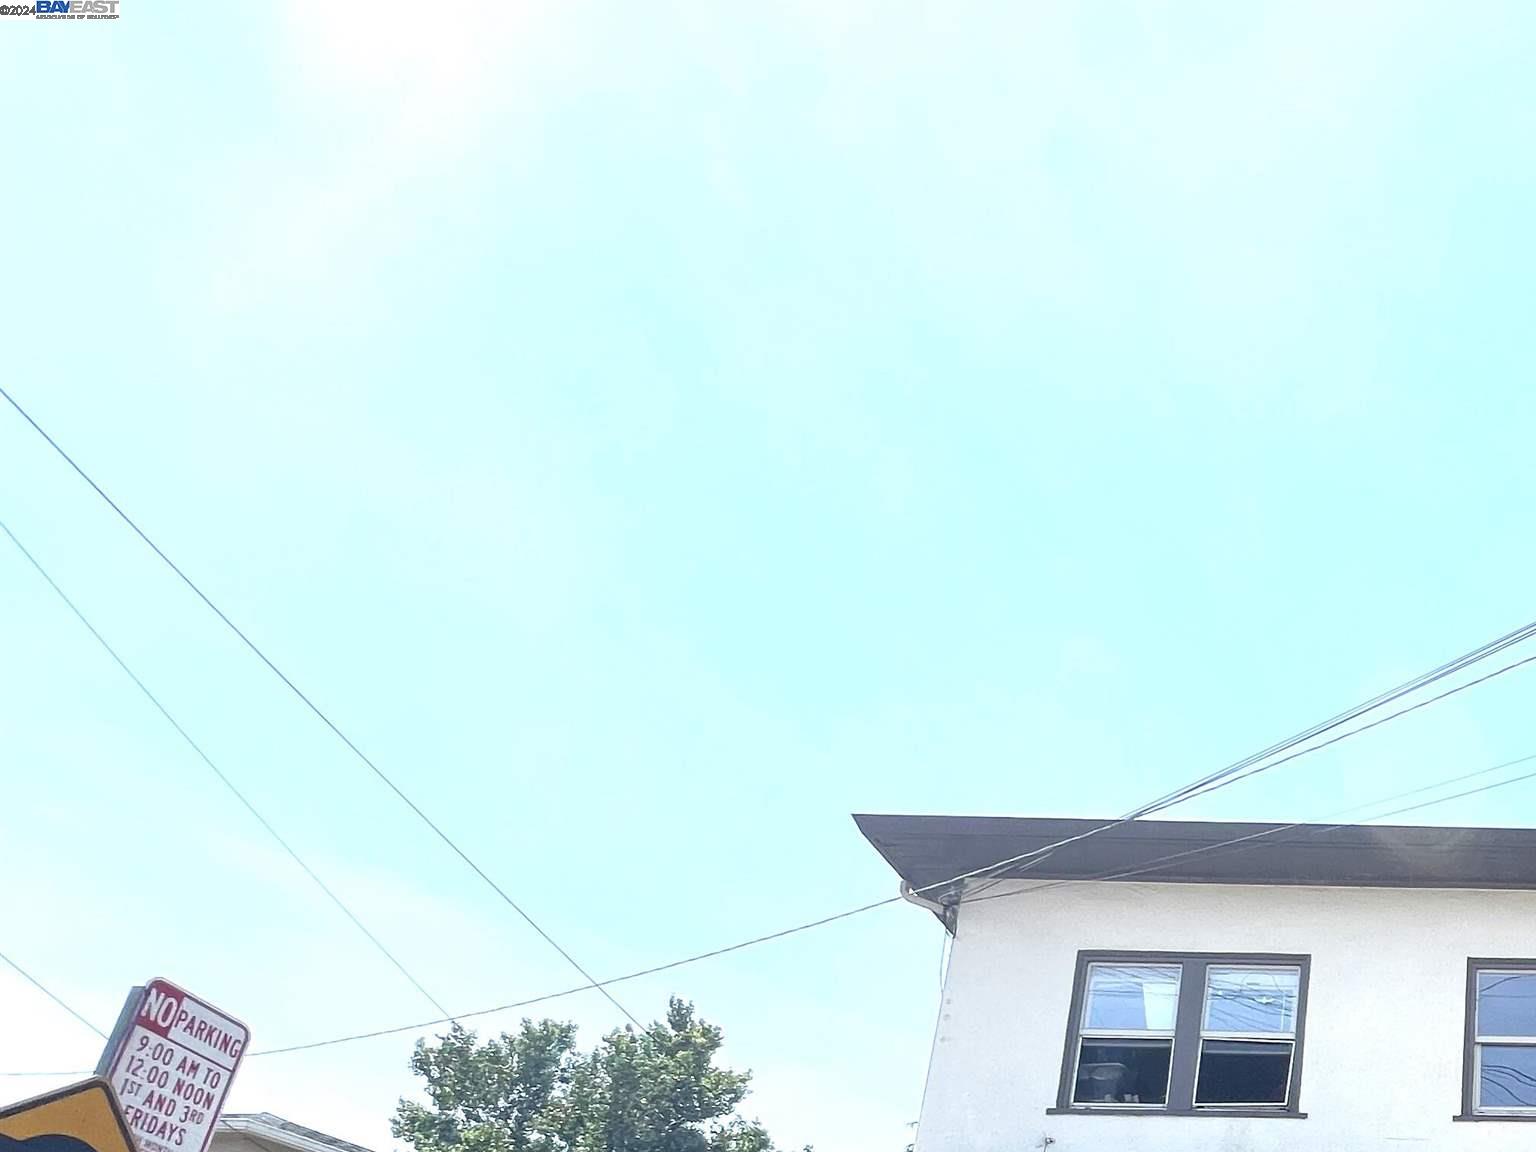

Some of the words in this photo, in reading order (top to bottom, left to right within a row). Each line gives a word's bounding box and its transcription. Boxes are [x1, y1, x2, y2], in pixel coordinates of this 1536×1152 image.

[140, 987, 178, 1028] NO
[174, 1009, 242, 1058] PARKING
[126, 1055, 169, 1088] 12:00
[172, 1078, 215, 1110] NOON
[136, 1035, 174, 1066] 9:00
[176, 1056, 200, 1079] AM
[203, 1067, 220, 1089] TO
[120, 1078, 142, 1096] 1ST
[142, 1090, 176, 1117] AND
[179, 1106, 204, 1125] 3RD
[124, 1104, 186, 1145] FRIDAYS
